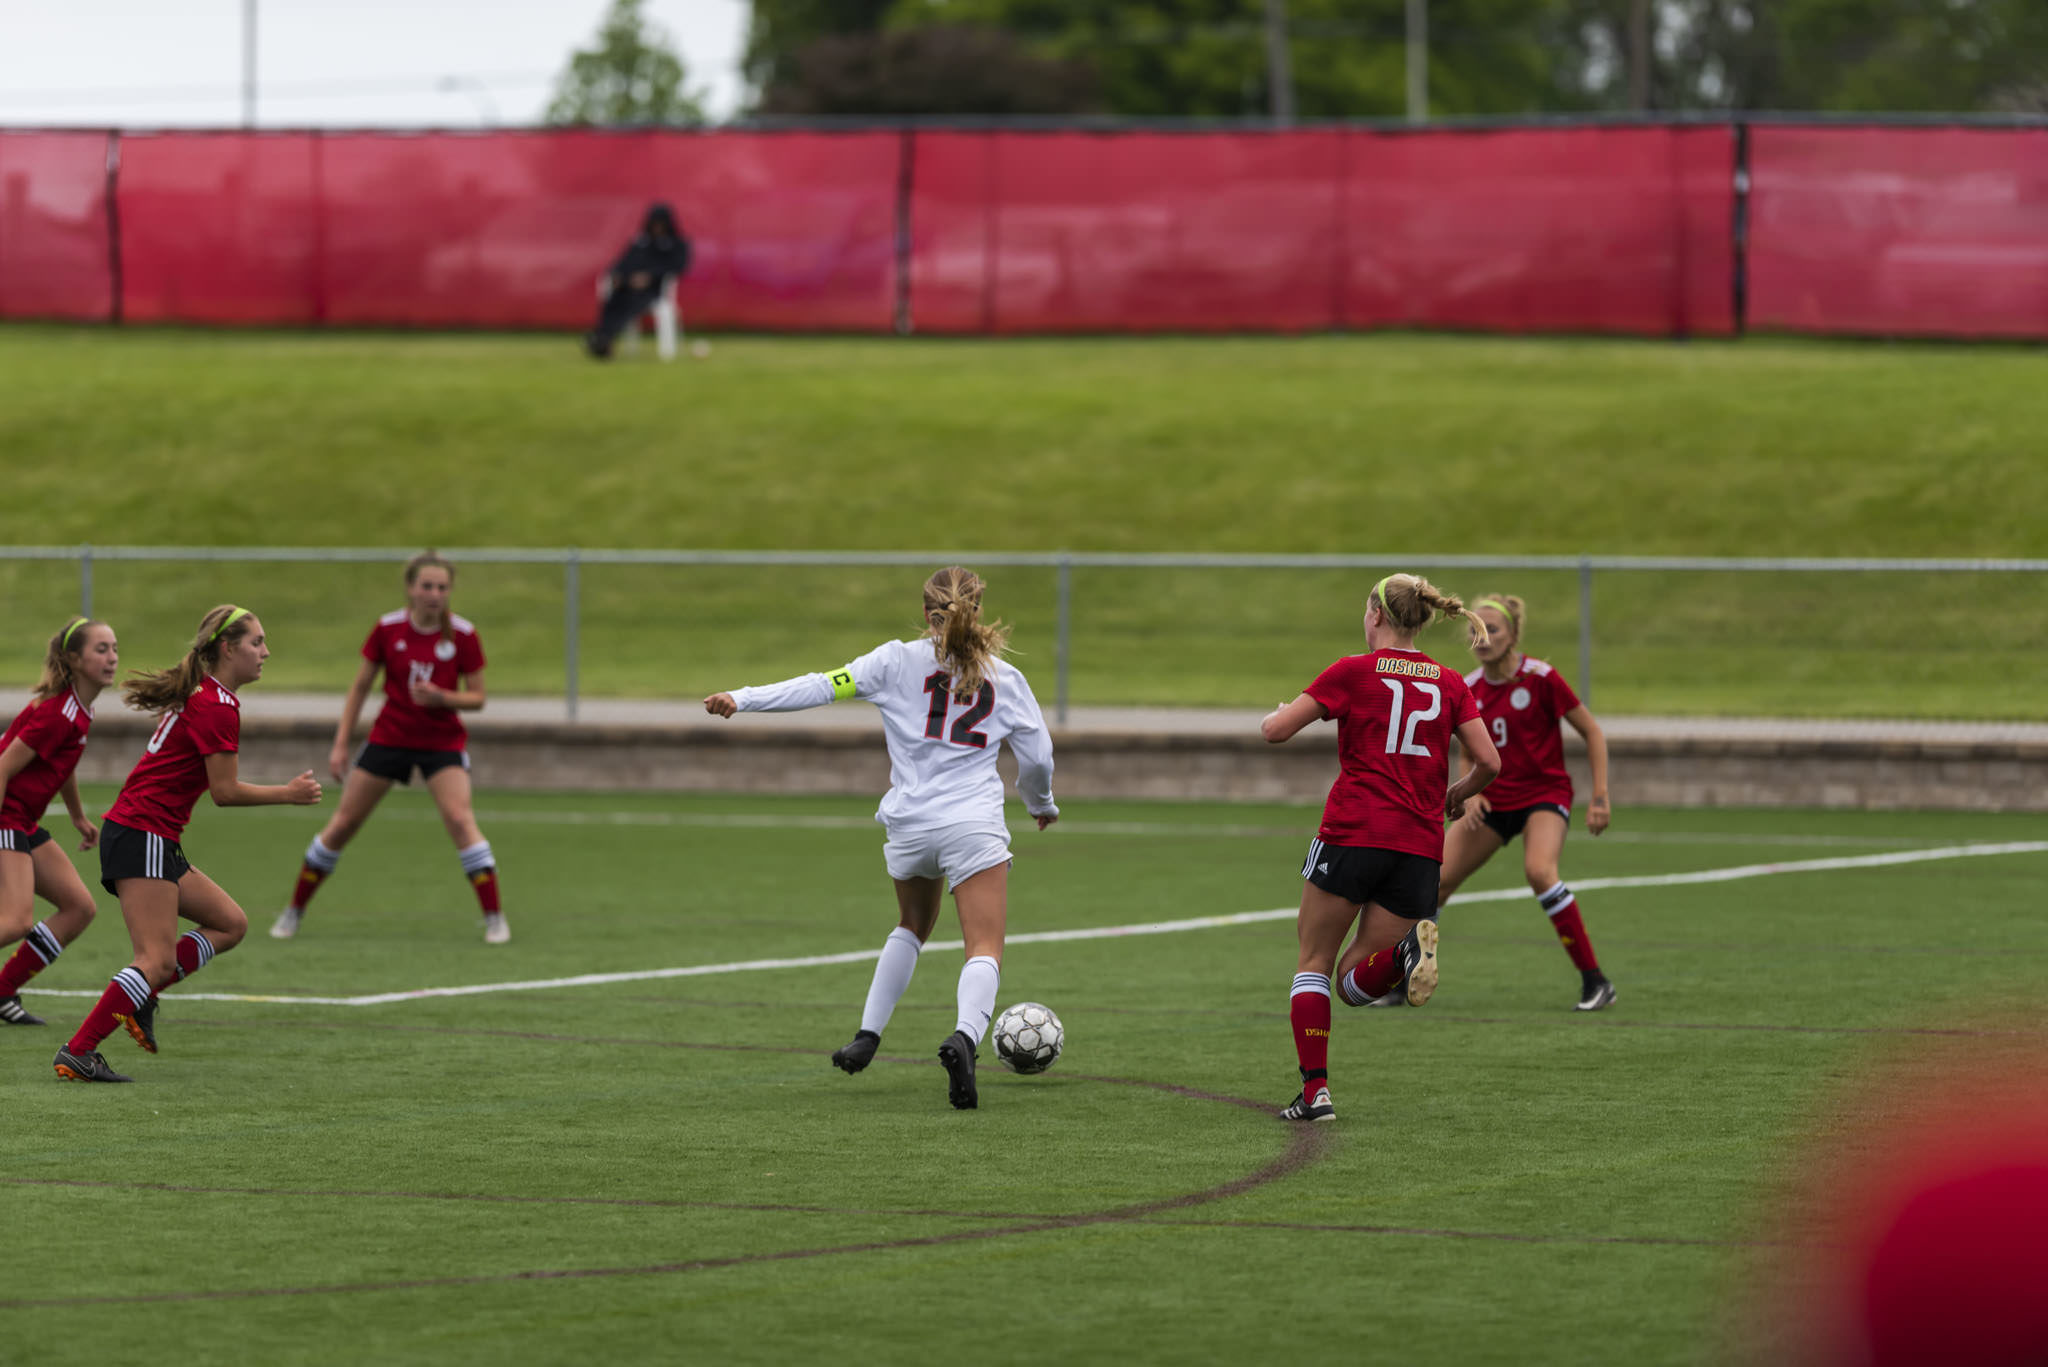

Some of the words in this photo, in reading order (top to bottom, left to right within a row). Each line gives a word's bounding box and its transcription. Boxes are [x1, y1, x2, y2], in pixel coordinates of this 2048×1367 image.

[832, 671, 851, 686] C
[1376, 657, 1441, 680] DASHERS
[923, 670, 995, 749] 12
[1380, 678, 1442, 757] 12
[1492, 716, 1508, 748] 9
